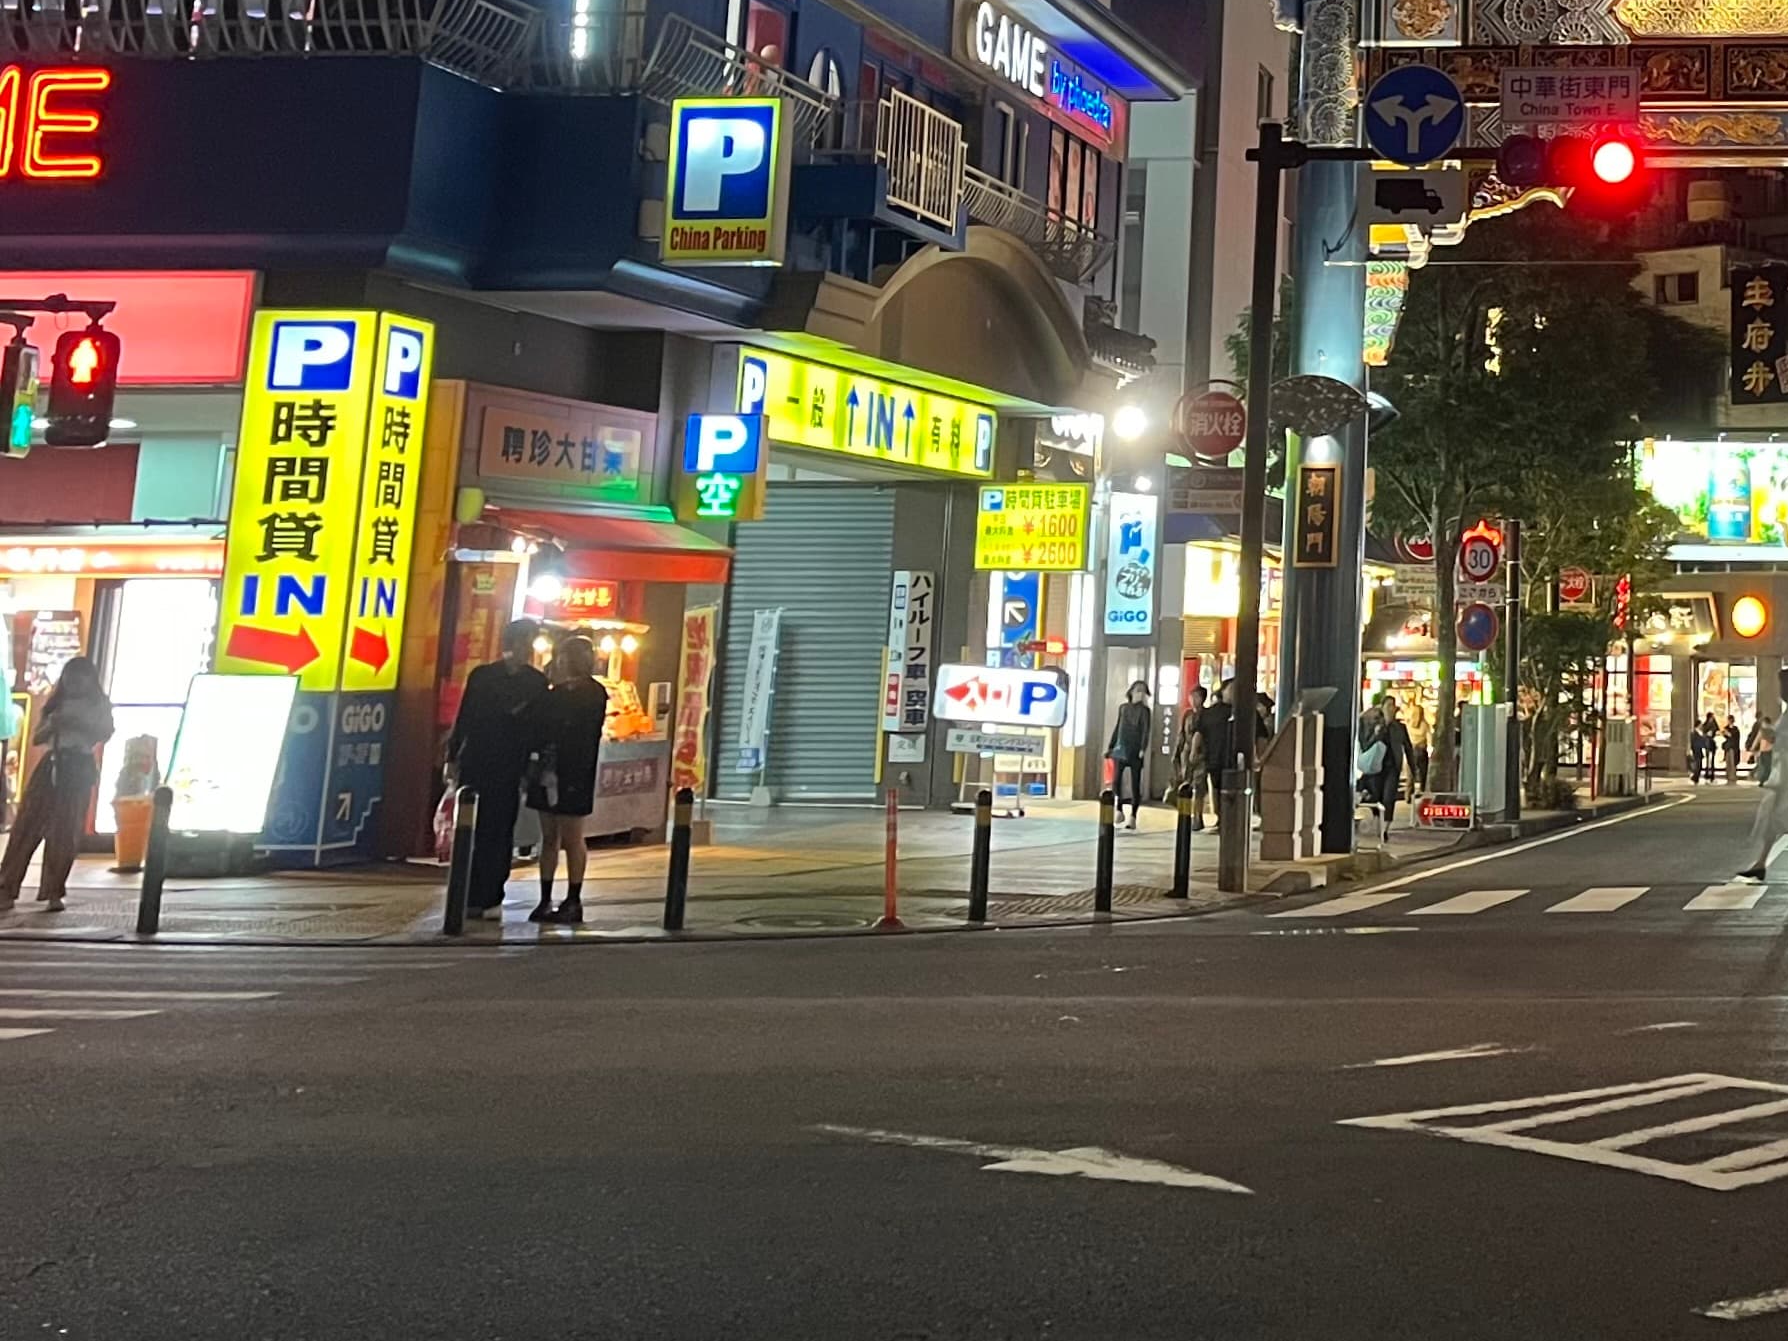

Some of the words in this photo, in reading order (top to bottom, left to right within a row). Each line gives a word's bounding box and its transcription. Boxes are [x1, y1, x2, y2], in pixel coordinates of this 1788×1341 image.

[976, 1, 1047, 98] GAME
[1510, 75, 1631, 99] 中華街東門
[1520, 102, 1559, 116] China
[1565, 103, 1600, 116] Town
[683, 117, 765, 213] P
[670, 228, 711, 252] China
[712, 227, 766, 254] Parking
[272, 326, 350, 388] P
[1741, 276, 1775, 397] 王府井
[385, 331, 422, 394] P
[741, 360, 765, 413] P
[697, 416, 748, 471] P
[866, 391, 896, 451] IN
[975, 417, 991, 469] P
[1190, 411, 1243, 437] 消火栓
[256, 400, 337, 562] 時間貸
[369, 406, 411, 566] 時間貸
[696, 475, 741, 517] 空
[1005, 489, 1081, 510] 時間貸駐車場
[1468, 548, 1490, 569] 30
[240, 575, 326, 617] IN
[358, 577, 397, 619] IN
[1107, 610, 1148, 623] GiGO
[906, 575, 932, 680] ハイルーフ車
[341, 703, 386, 734] GiGO
[1018, 681, 1058, 716] P
